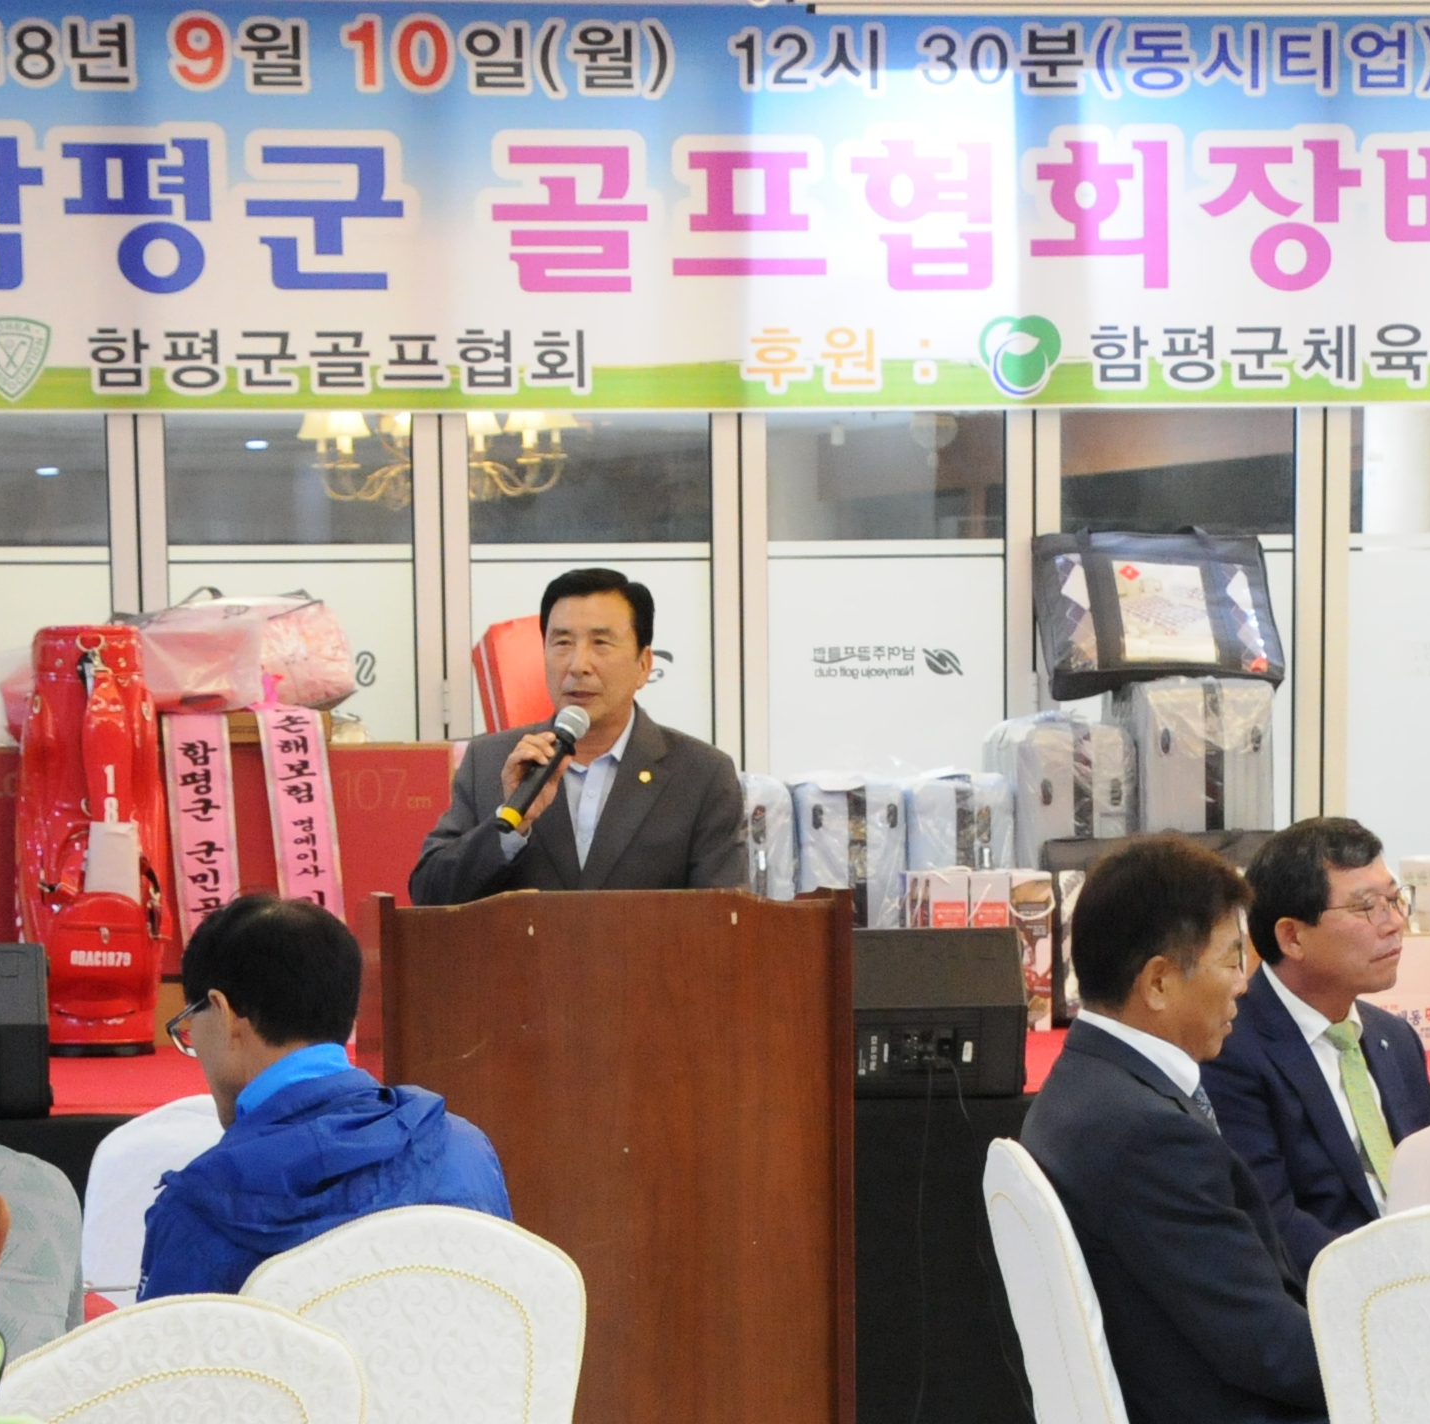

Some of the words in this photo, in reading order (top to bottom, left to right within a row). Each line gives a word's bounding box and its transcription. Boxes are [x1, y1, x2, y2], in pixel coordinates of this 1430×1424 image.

[175, 18, 303, 88] 9월
[346, 18, 670, 92] 10일(월)
[733, 28, 880, 90] 12시
[87, 327, 588, 389] 함평군골프협회
[749, 326, 877, 387] 후원
[178, 740, 222, 822] 함평군
[272, 709, 317, 804] 손해보험
